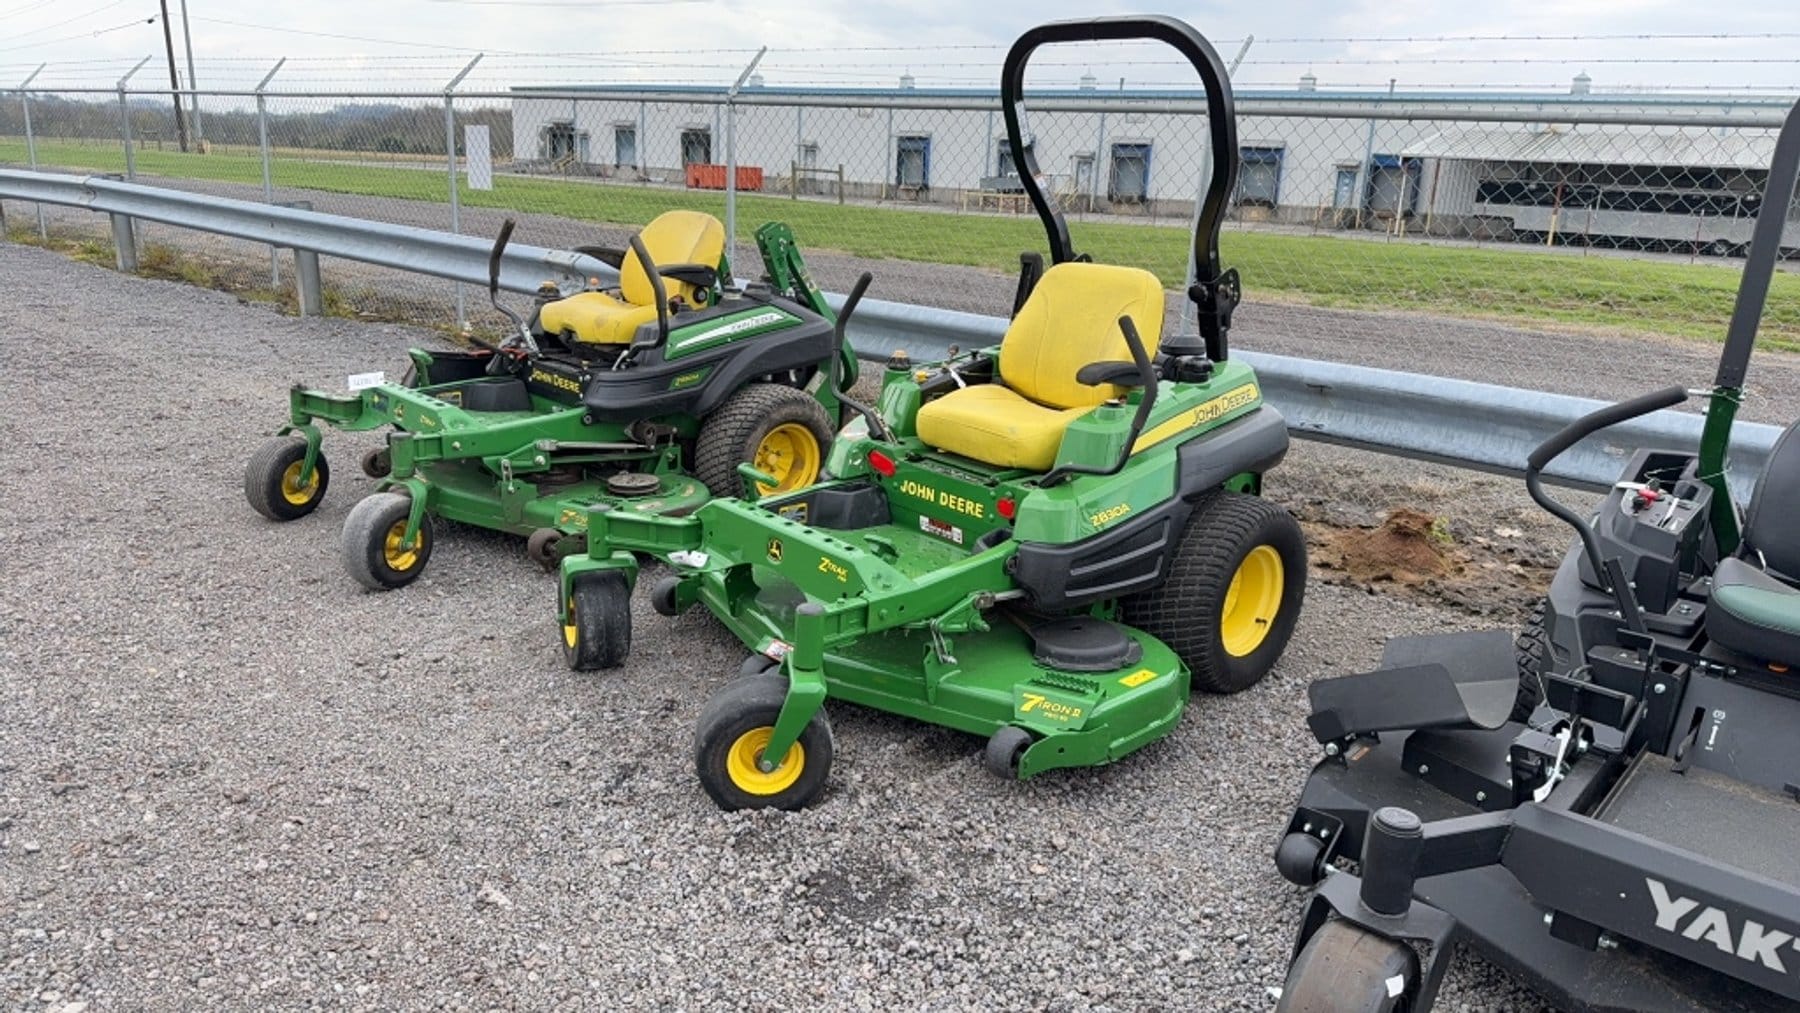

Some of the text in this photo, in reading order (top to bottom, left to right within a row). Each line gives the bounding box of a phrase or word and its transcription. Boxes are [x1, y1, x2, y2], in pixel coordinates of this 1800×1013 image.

[553, 374, 580, 393] DEERE
[1192, 388, 1253, 424] JOHN DEERE
[900, 480, 984, 519] JOHN DEERE
[1645, 877, 1800, 975] YAK
